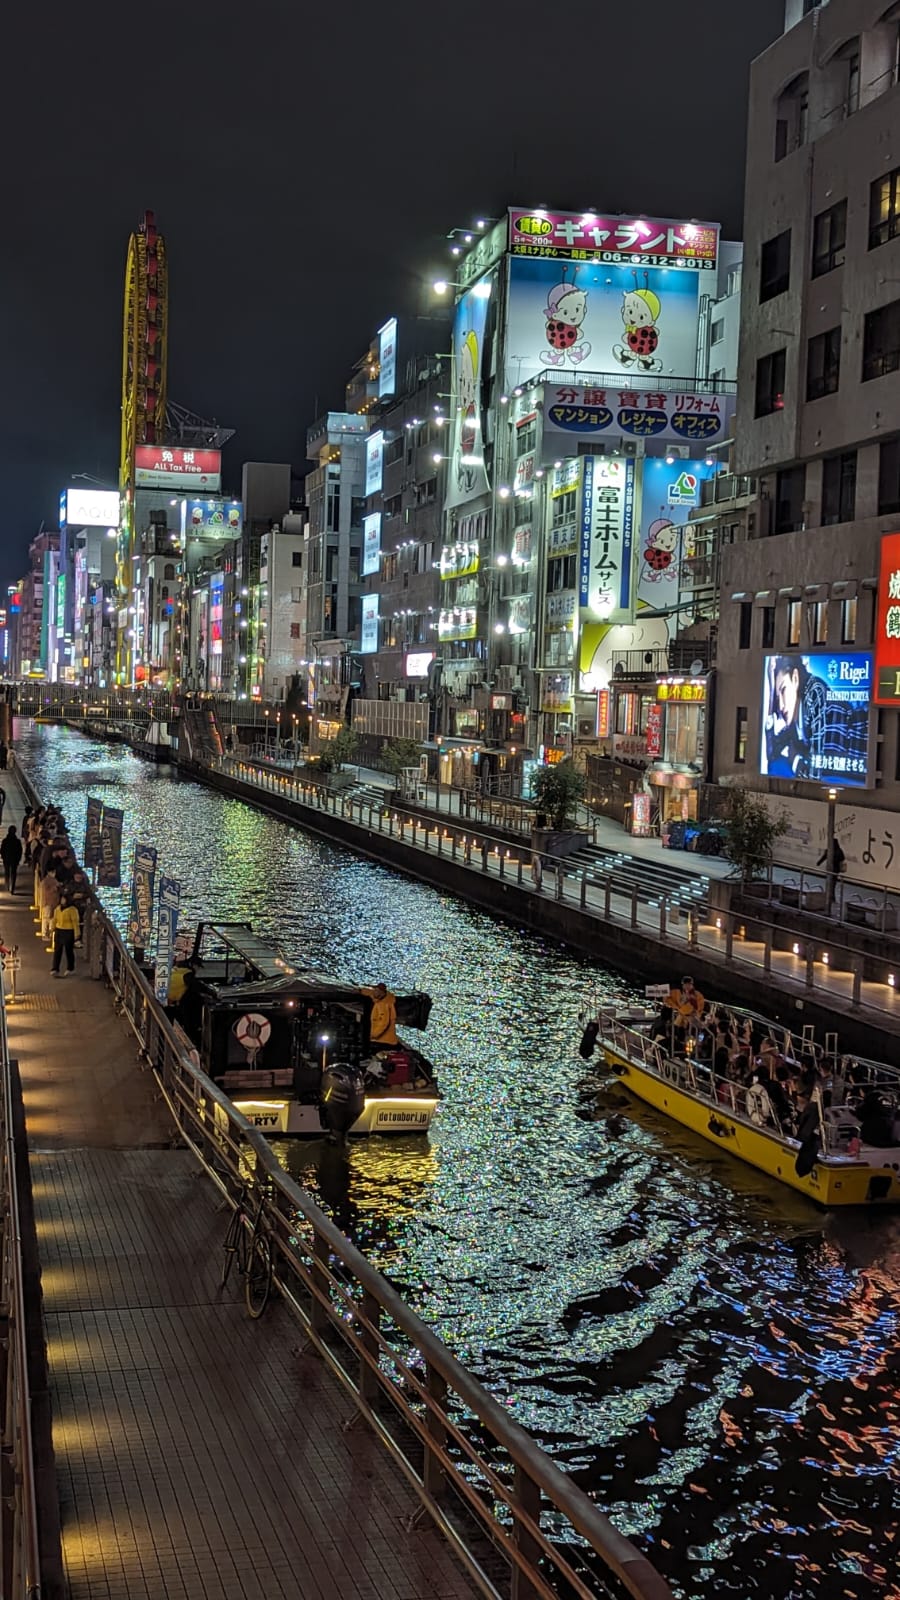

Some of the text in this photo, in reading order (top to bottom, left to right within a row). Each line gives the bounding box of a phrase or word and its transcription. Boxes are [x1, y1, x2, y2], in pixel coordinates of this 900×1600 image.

[556, 388, 721, 413] 分譲 賃貸 リフォーム
[553, 408, 611, 425] マンション
[621, 412, 667, 426] レジャー
[674, 416, 718, 430] オフィス
[633, 426, 653, 434] ビル
[687, 430, 707, 438] ビル
[161, 450, 195, 464] 免税
[154, 463, 202, 473] ALL Tax Free
[594, 485, 621, 604] 富士ホームサービス
[839, 660, 869, 685] Rigel
[135, 871, 152, 939] CRUISE
